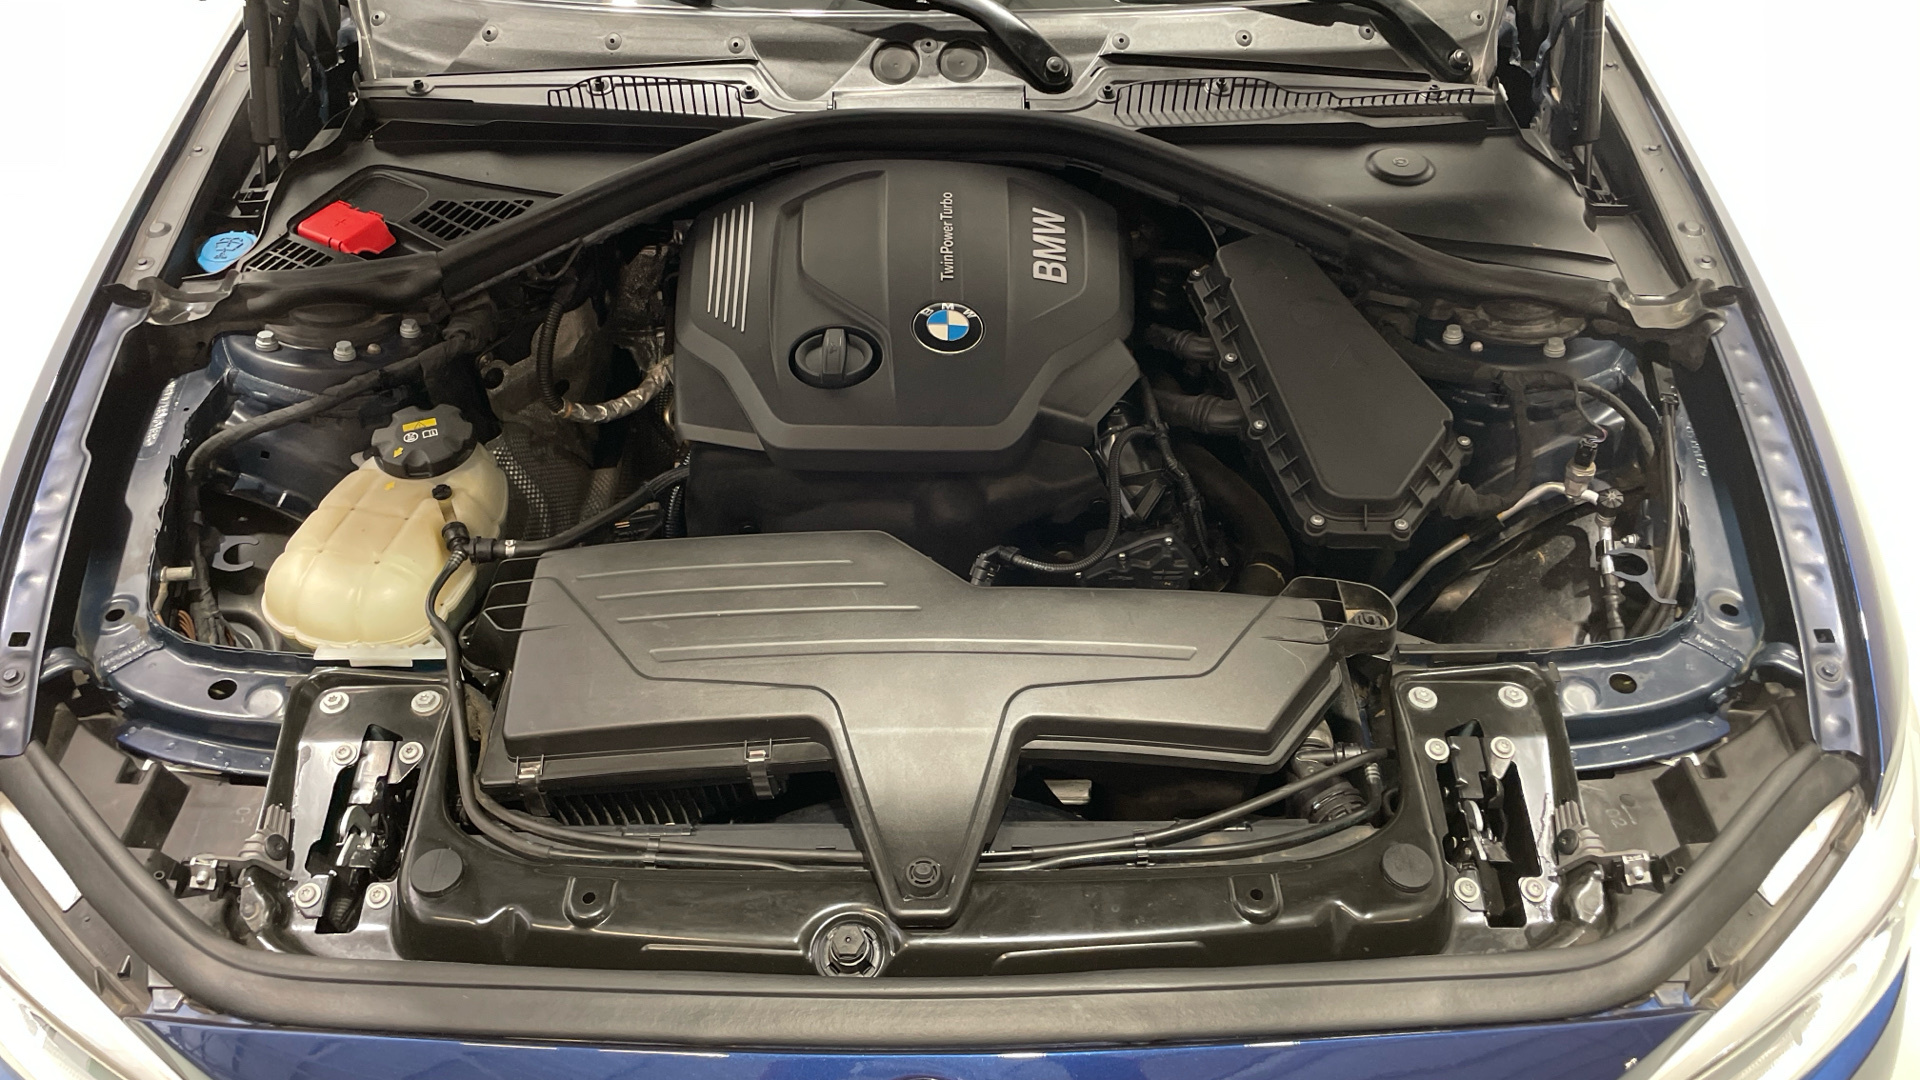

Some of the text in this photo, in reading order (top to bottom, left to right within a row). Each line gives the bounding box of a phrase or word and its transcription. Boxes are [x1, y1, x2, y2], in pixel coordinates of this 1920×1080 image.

[940, 192, 954, 281] TwinPower Turbo
[1032, 206, 1068, 284] BMW
[920, 302, 978, 319] BMW
